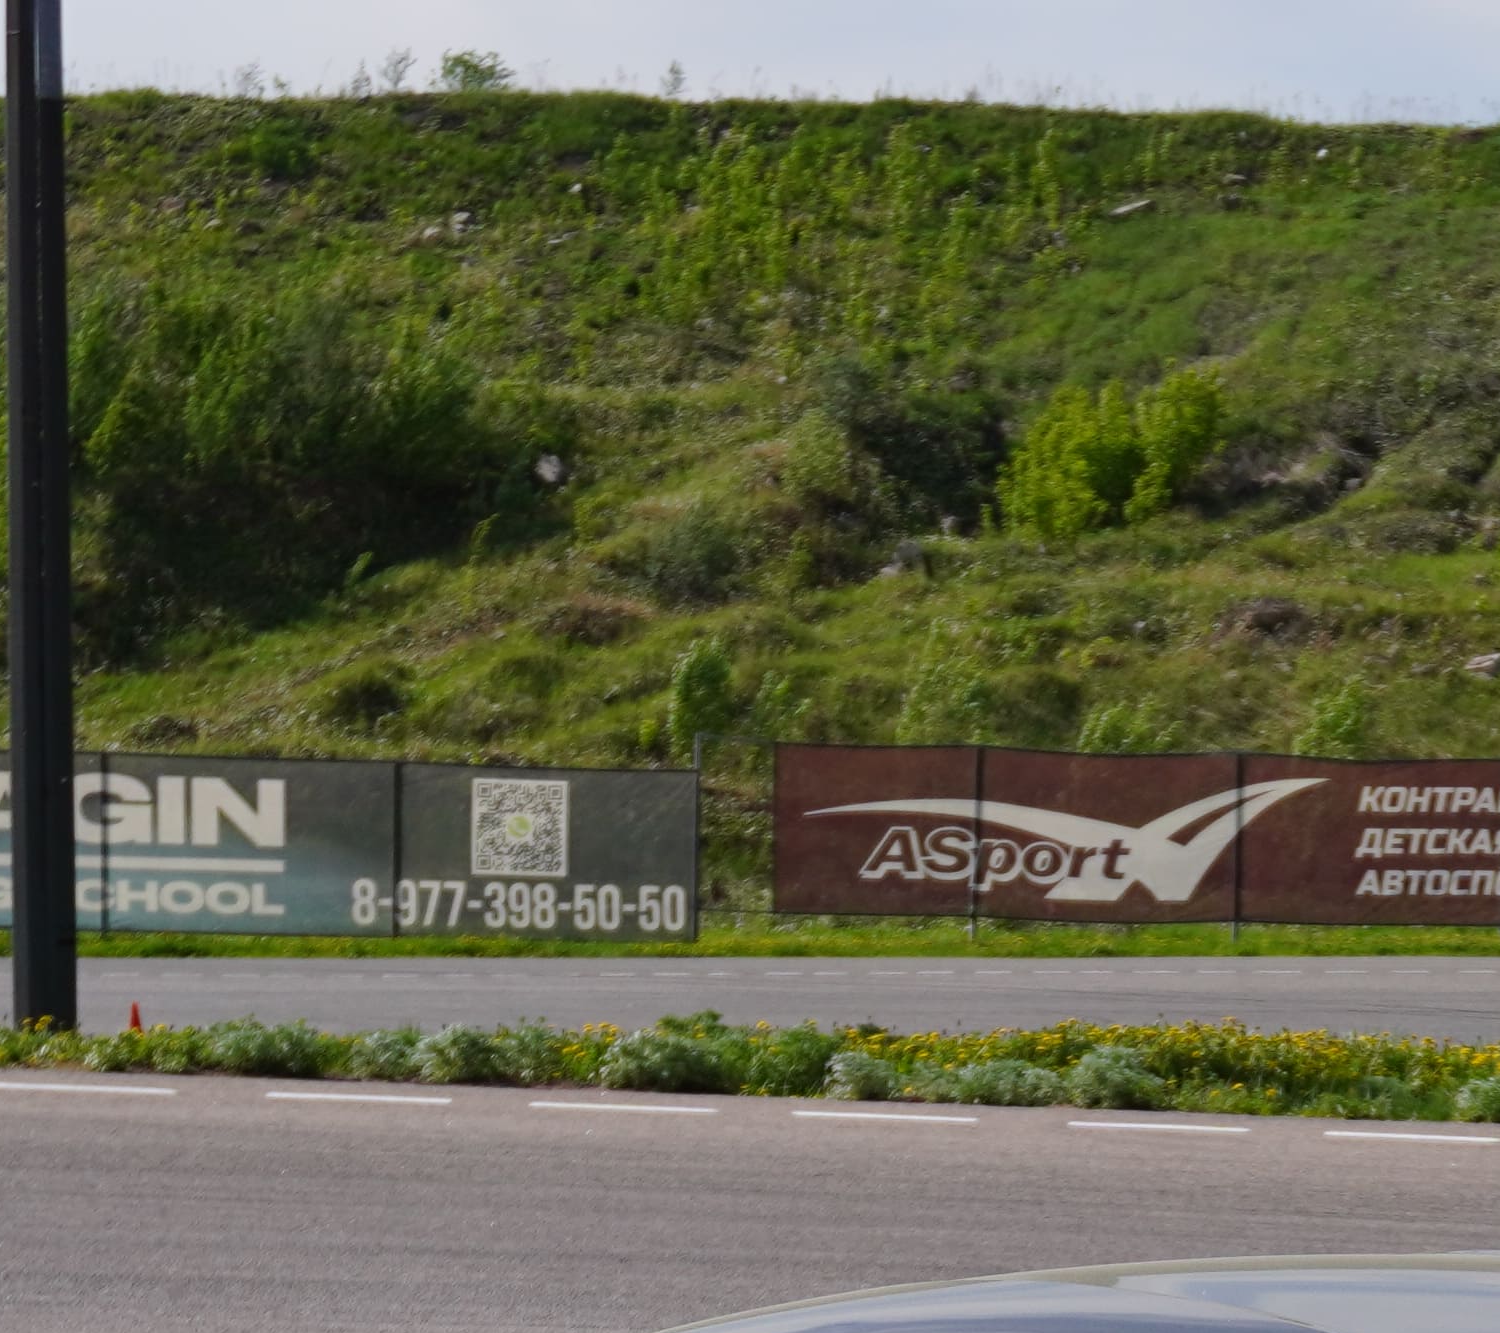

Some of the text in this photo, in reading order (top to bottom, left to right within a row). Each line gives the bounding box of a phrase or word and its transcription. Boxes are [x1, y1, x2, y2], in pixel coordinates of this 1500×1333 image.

[858, 826, 1131, 890] ASport
[75, 877, 285, 916] CHOOL
[351, 877, 687, 932] 8-977-398-50-50
